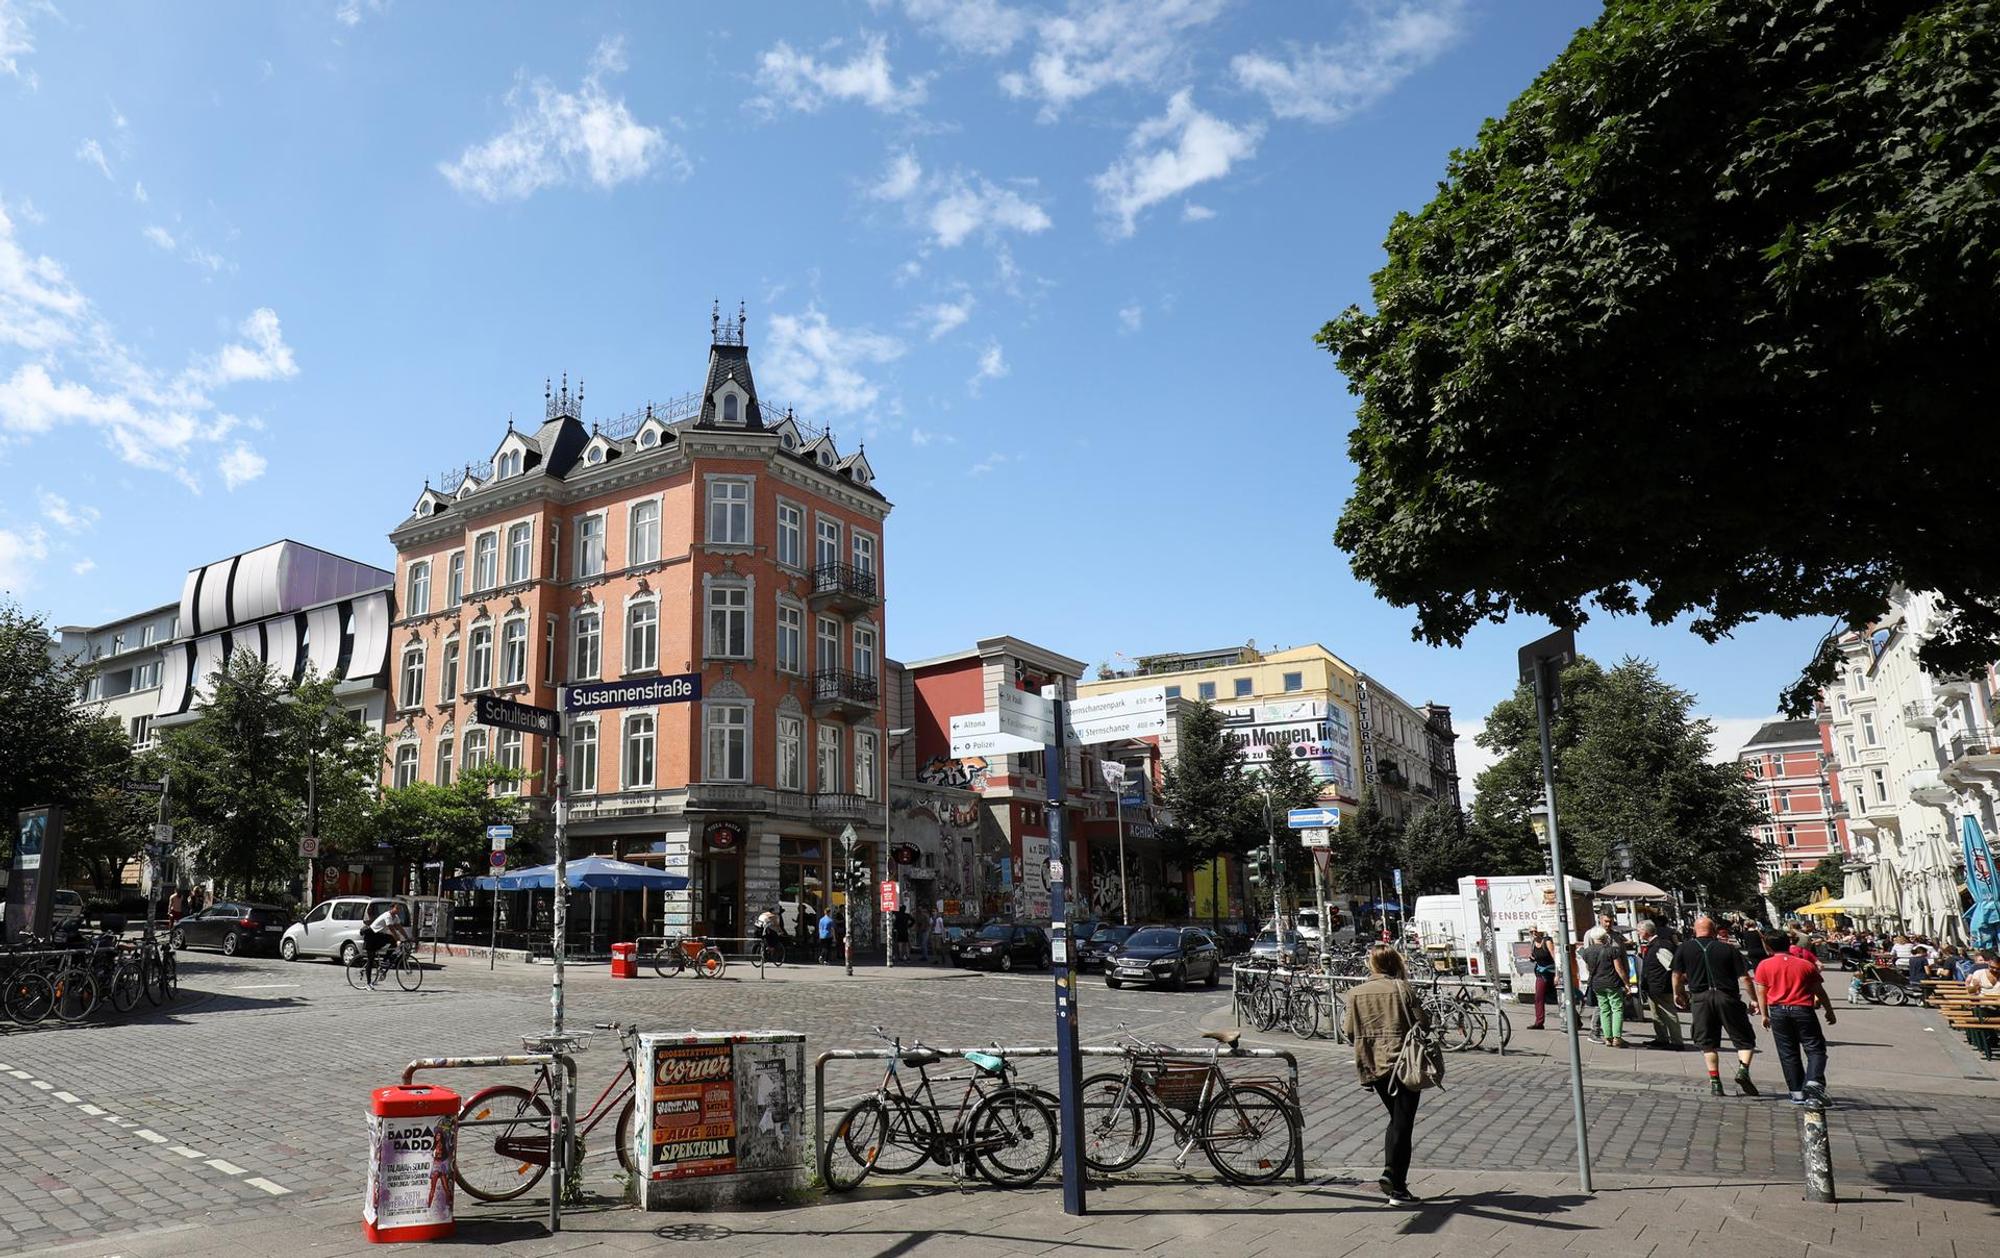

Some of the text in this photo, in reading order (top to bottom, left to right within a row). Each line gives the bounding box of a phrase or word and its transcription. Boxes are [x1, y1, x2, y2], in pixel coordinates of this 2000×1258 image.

[573, 678, 692, 706] Susannenstraße
[485, 700, 552, 731] Schulterbltt
[1066, 699, 1125, 716] Sternschanzenpark
[963, 720, 986, 729] Altona
[1085, 723, 1130, 738] Sternschanze
[1252, 725, 1316, 747] Morgen,
[973, 742, 995, 750] Polizei
[1309, 745, 1320, 755] Er
[656, 1056, 731, 1085] Corner
[387, 1126, 434, 1140] BADDA
[666, 1127, 699, 1141] AUG
[706, 1124, 730, 1137] 2017
[660, 1139, 730, 1161] SPEKTRUM
[412, 1162, 430, 1171] SOUND
